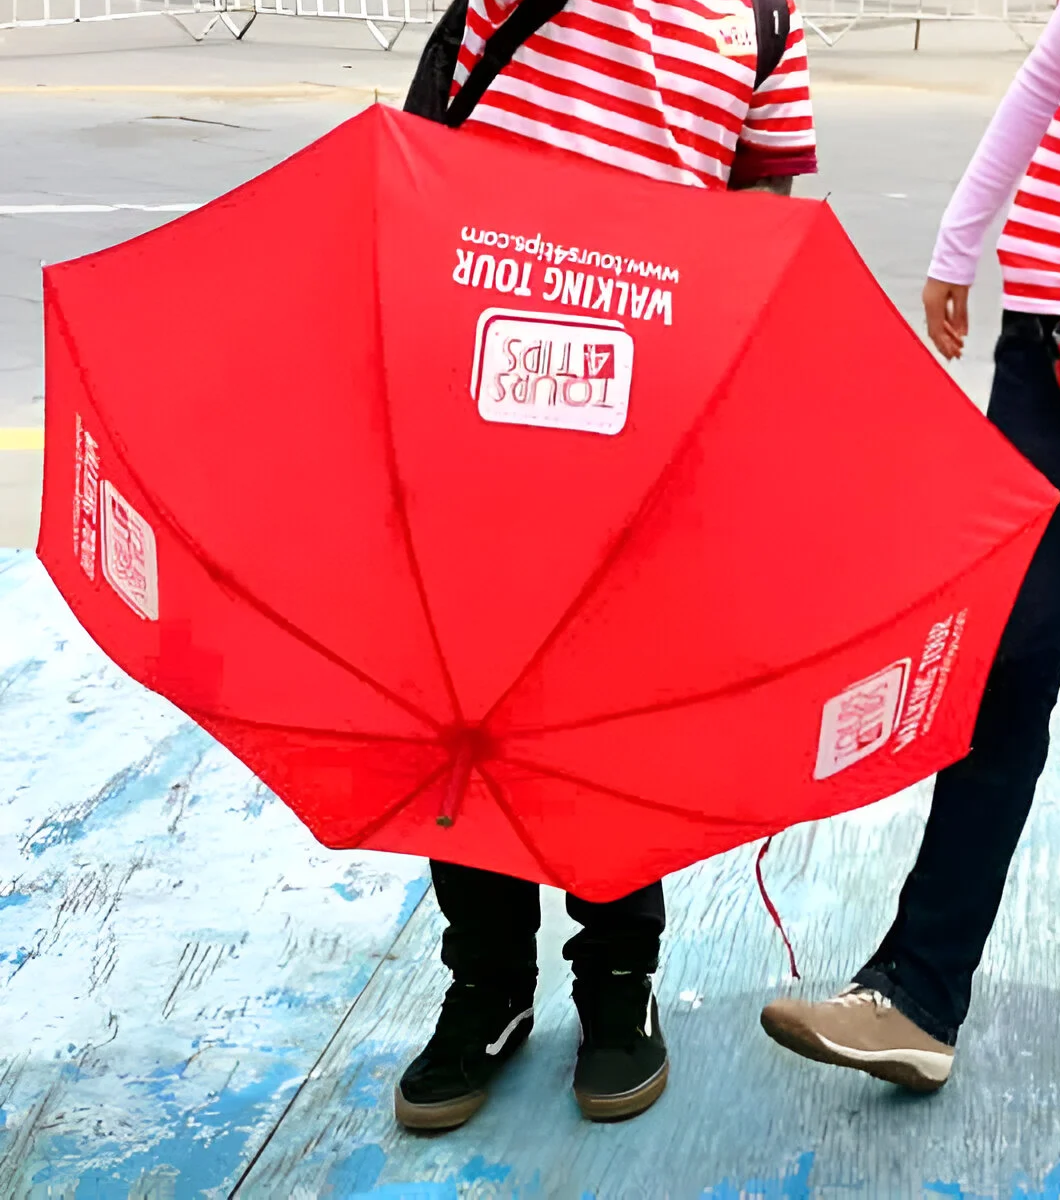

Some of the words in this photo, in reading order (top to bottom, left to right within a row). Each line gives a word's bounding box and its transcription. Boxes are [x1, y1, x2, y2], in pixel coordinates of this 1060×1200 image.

[452, 248, 533, 298] TOUR
[460, 225, 680, 284] www.tours4tips.com
[542, 266, 673, 327] WALKING
[493, 372, 615, 409] TOURS
